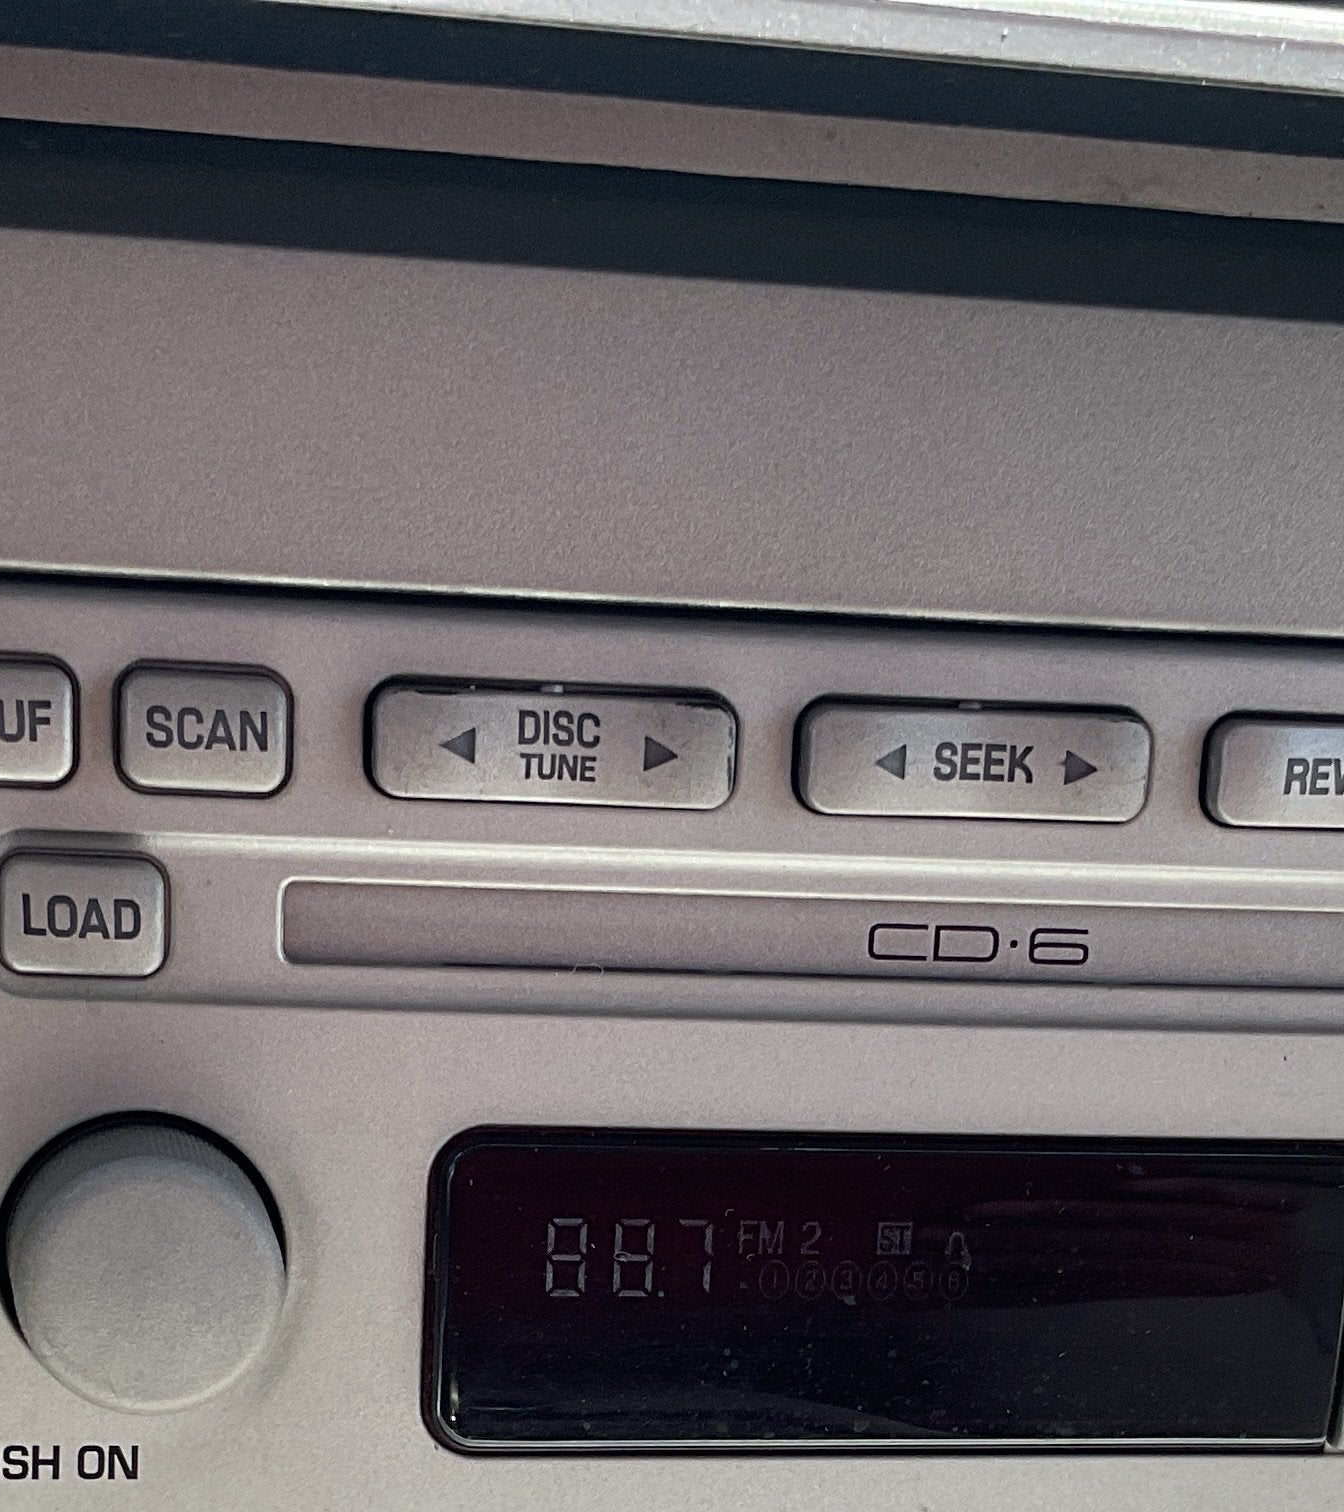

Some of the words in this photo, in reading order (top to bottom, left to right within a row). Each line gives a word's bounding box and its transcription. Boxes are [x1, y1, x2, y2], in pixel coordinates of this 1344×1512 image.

[144, 705, 270, 755] SCAN
[517, 709, 603, 750] DISC
[520, 752, 598, 784] TUNE
[932, 743, 1034, 786] SEEK
[20, 893, 143, 942] LOAD
[545, 1216, 714, 1298] 88.7
[739, 1219, 785, 1255] FM
[801, 1220, 823, 1255] 2
[76, 1444, 140, 1481] ON
